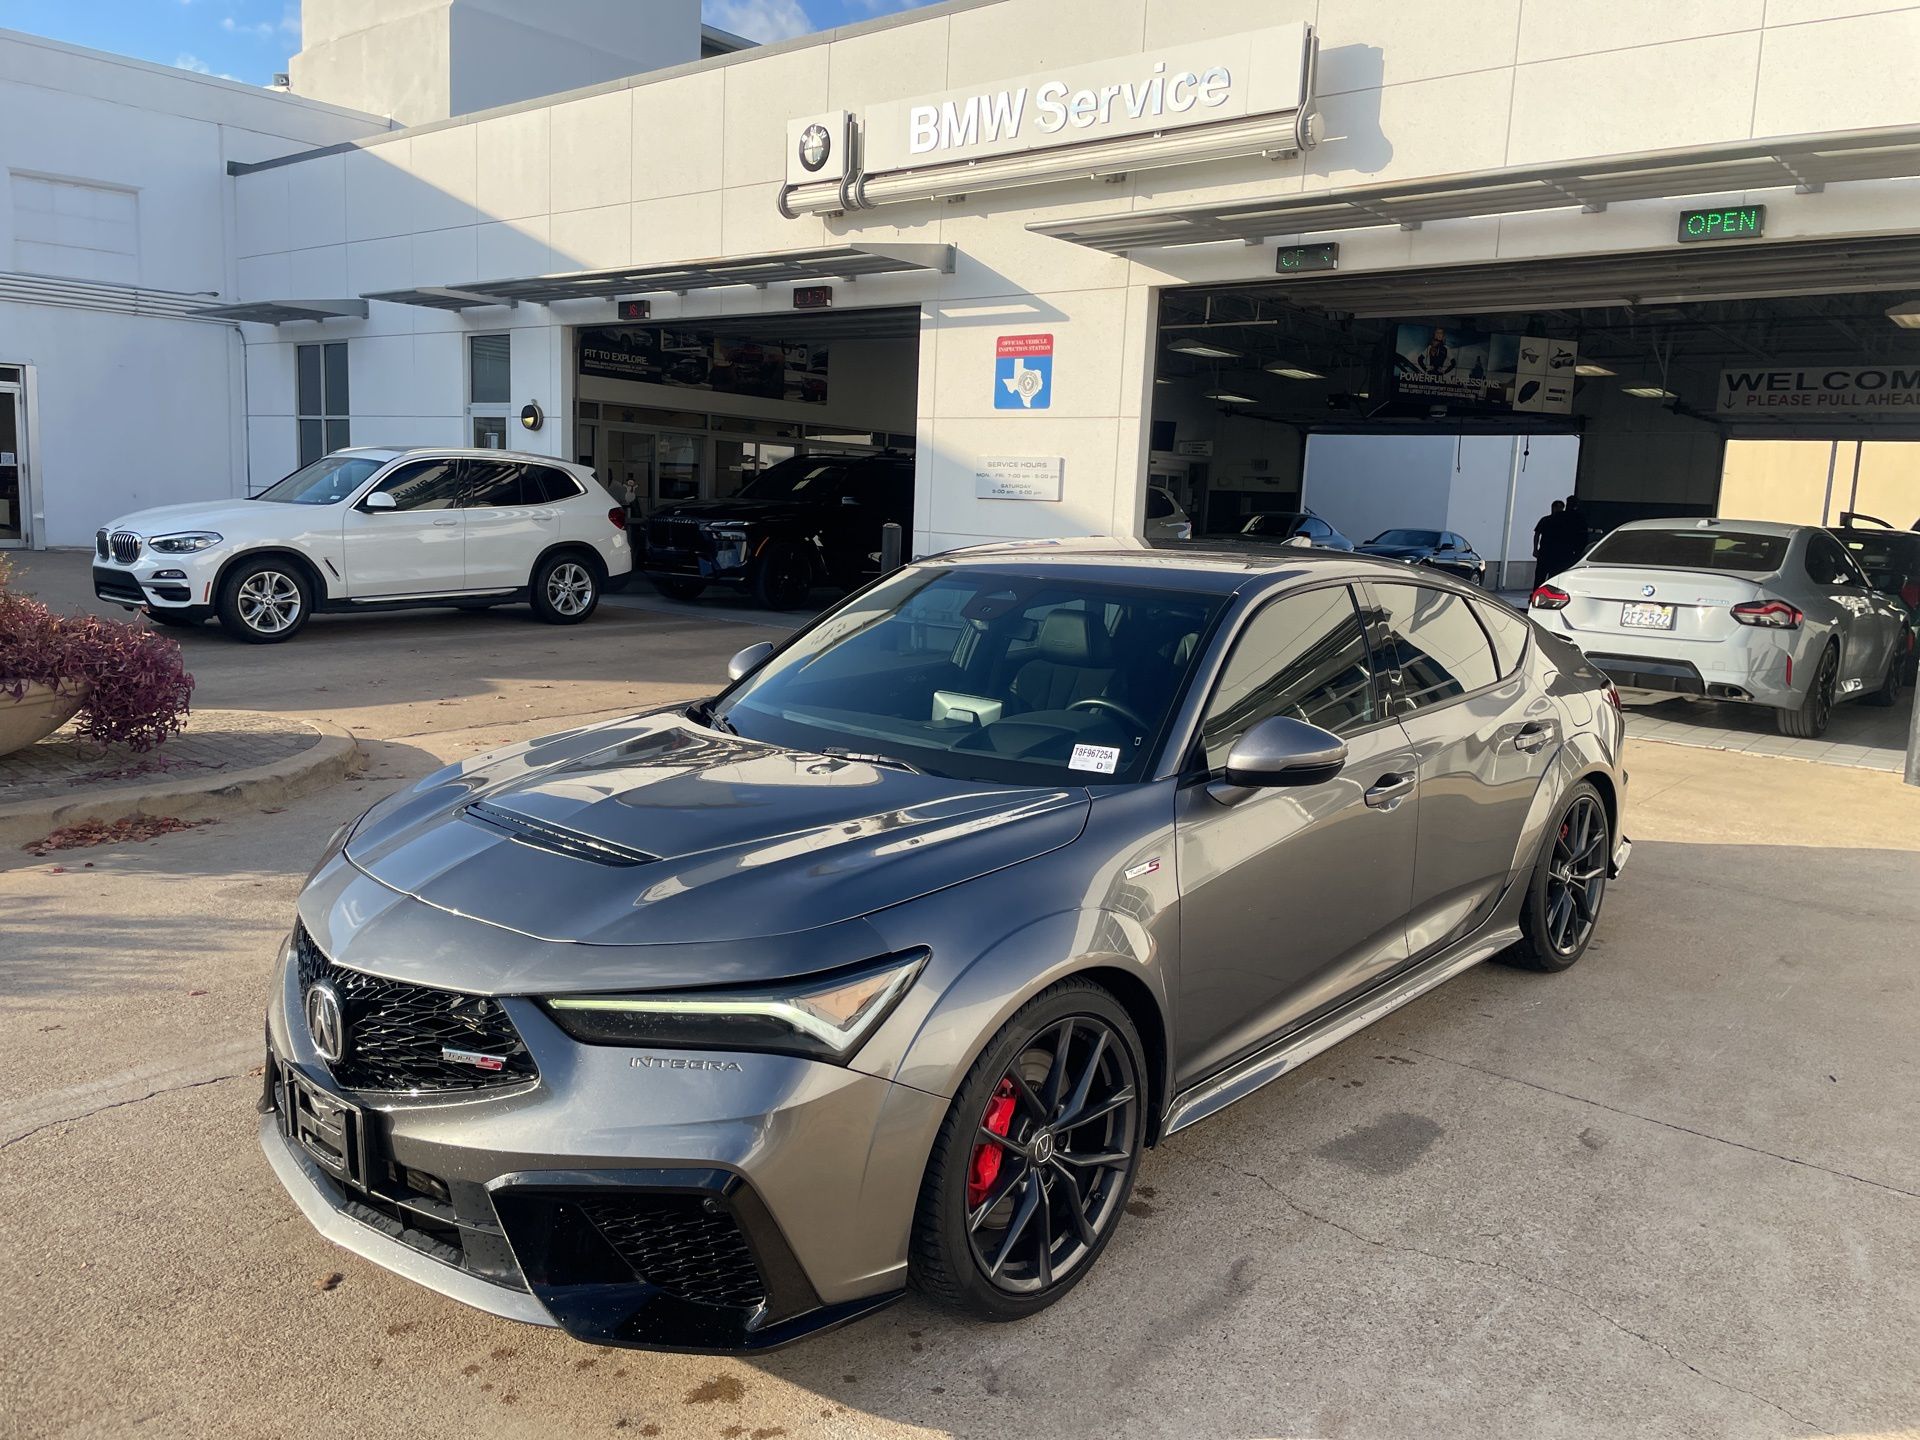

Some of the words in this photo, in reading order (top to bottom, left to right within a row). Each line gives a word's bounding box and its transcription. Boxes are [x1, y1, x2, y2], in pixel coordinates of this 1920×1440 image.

[910, 88, 1028, 154] BMW
[1035, 62, 1230, 134] Service
[1687, 210, 1756, 235] OPEN
[585, 348, 597, 358] FIT
[599, 350, 610, 360] TO
[612, 352, 648, 365] EXPLORE.
[1400, 371, 1445, 384] POWERFUL
[1746, 393, 1810, 406] PLEASE
[1817, 393, 1861, 406] PULL
[629, 1057, 743, 1072] INTEGRA
